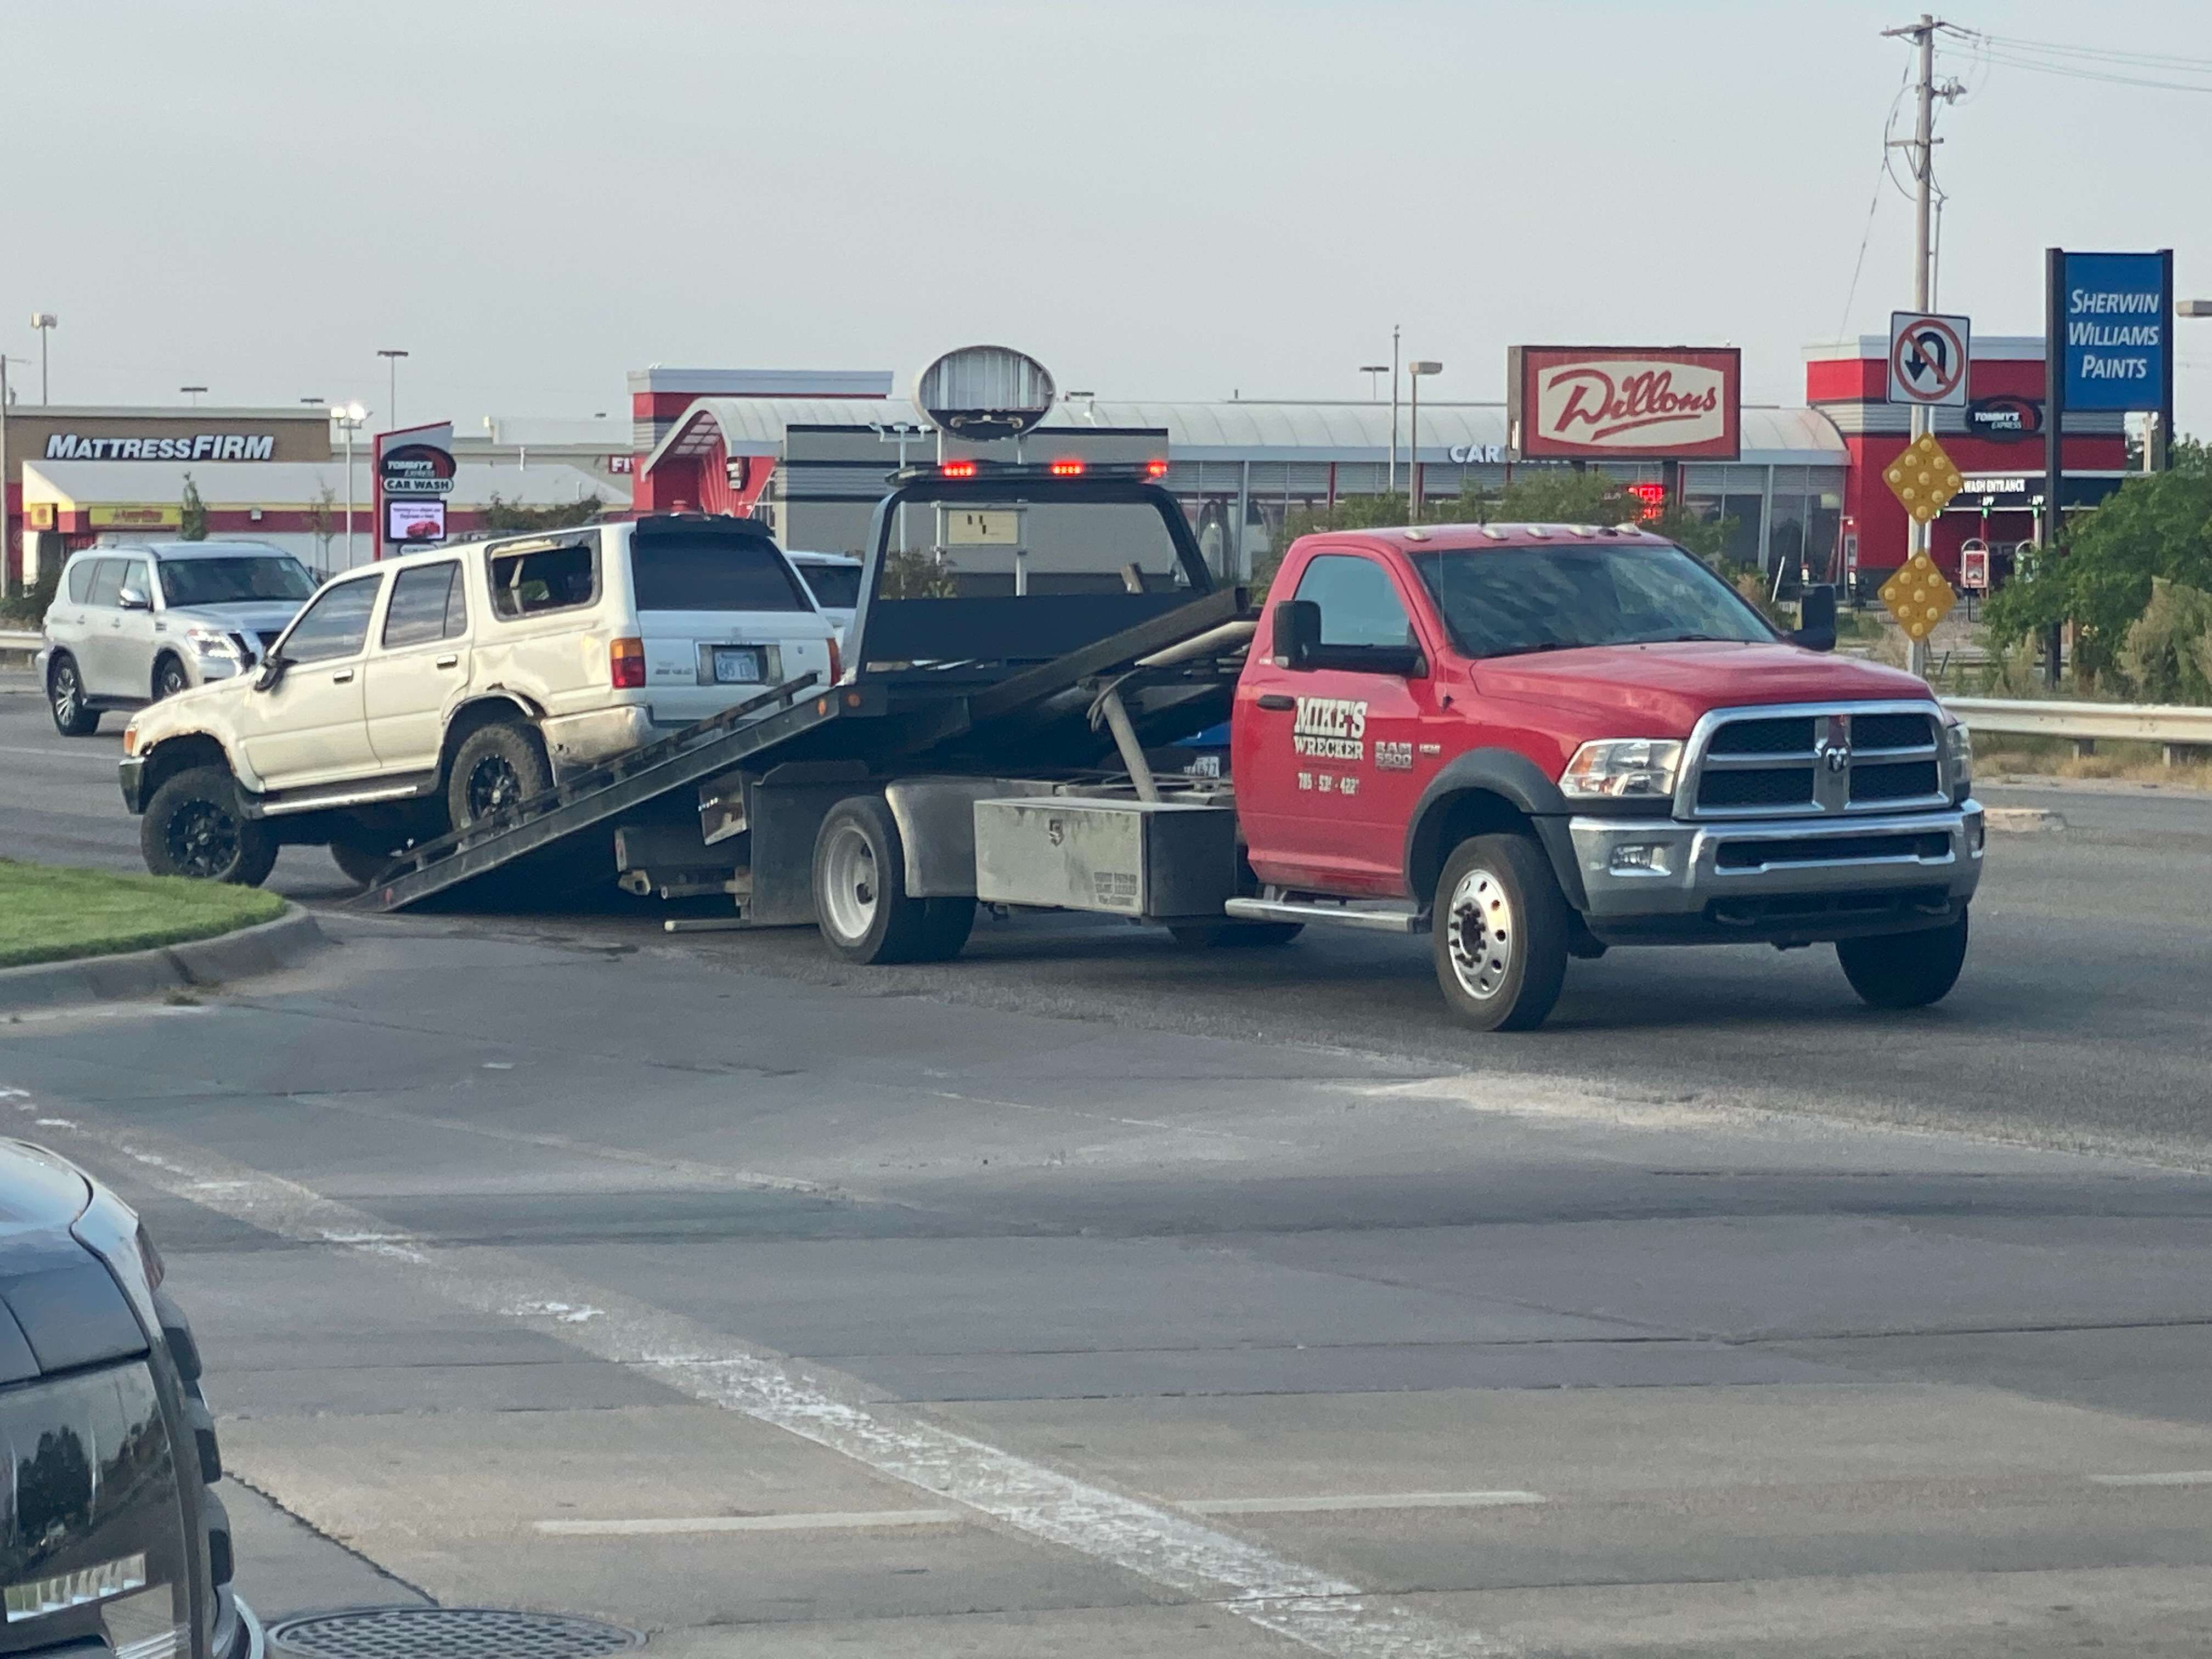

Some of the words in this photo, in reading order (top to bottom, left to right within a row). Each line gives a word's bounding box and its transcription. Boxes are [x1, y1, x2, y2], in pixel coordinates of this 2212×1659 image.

[2070, 289, 2159, 314] SHERWIN
[2069, 321, 2159, 346] WILLIAMS
[2081, 354, 2147, 379] PAINTS
[1547, 368, 1717, 433] Dillons
[1974, 412, 2019, 421] TOMMY'S
[1991, 421, 2022, 430] EXPRESS
[1449, 444, 1500, 463] CAR
[387, 479, 410, 489] CAR
[414, 480, 449, 489] WASH
[1963, 480, 1986, 493] WASH
[1986, 478, 2025, 493] ENTRANCE
[1294, 697, 1368, 738] MIKE'S
[1294, 735, 1364, 761] WRECKER
[1375, 741, 1412, 754] RAM
